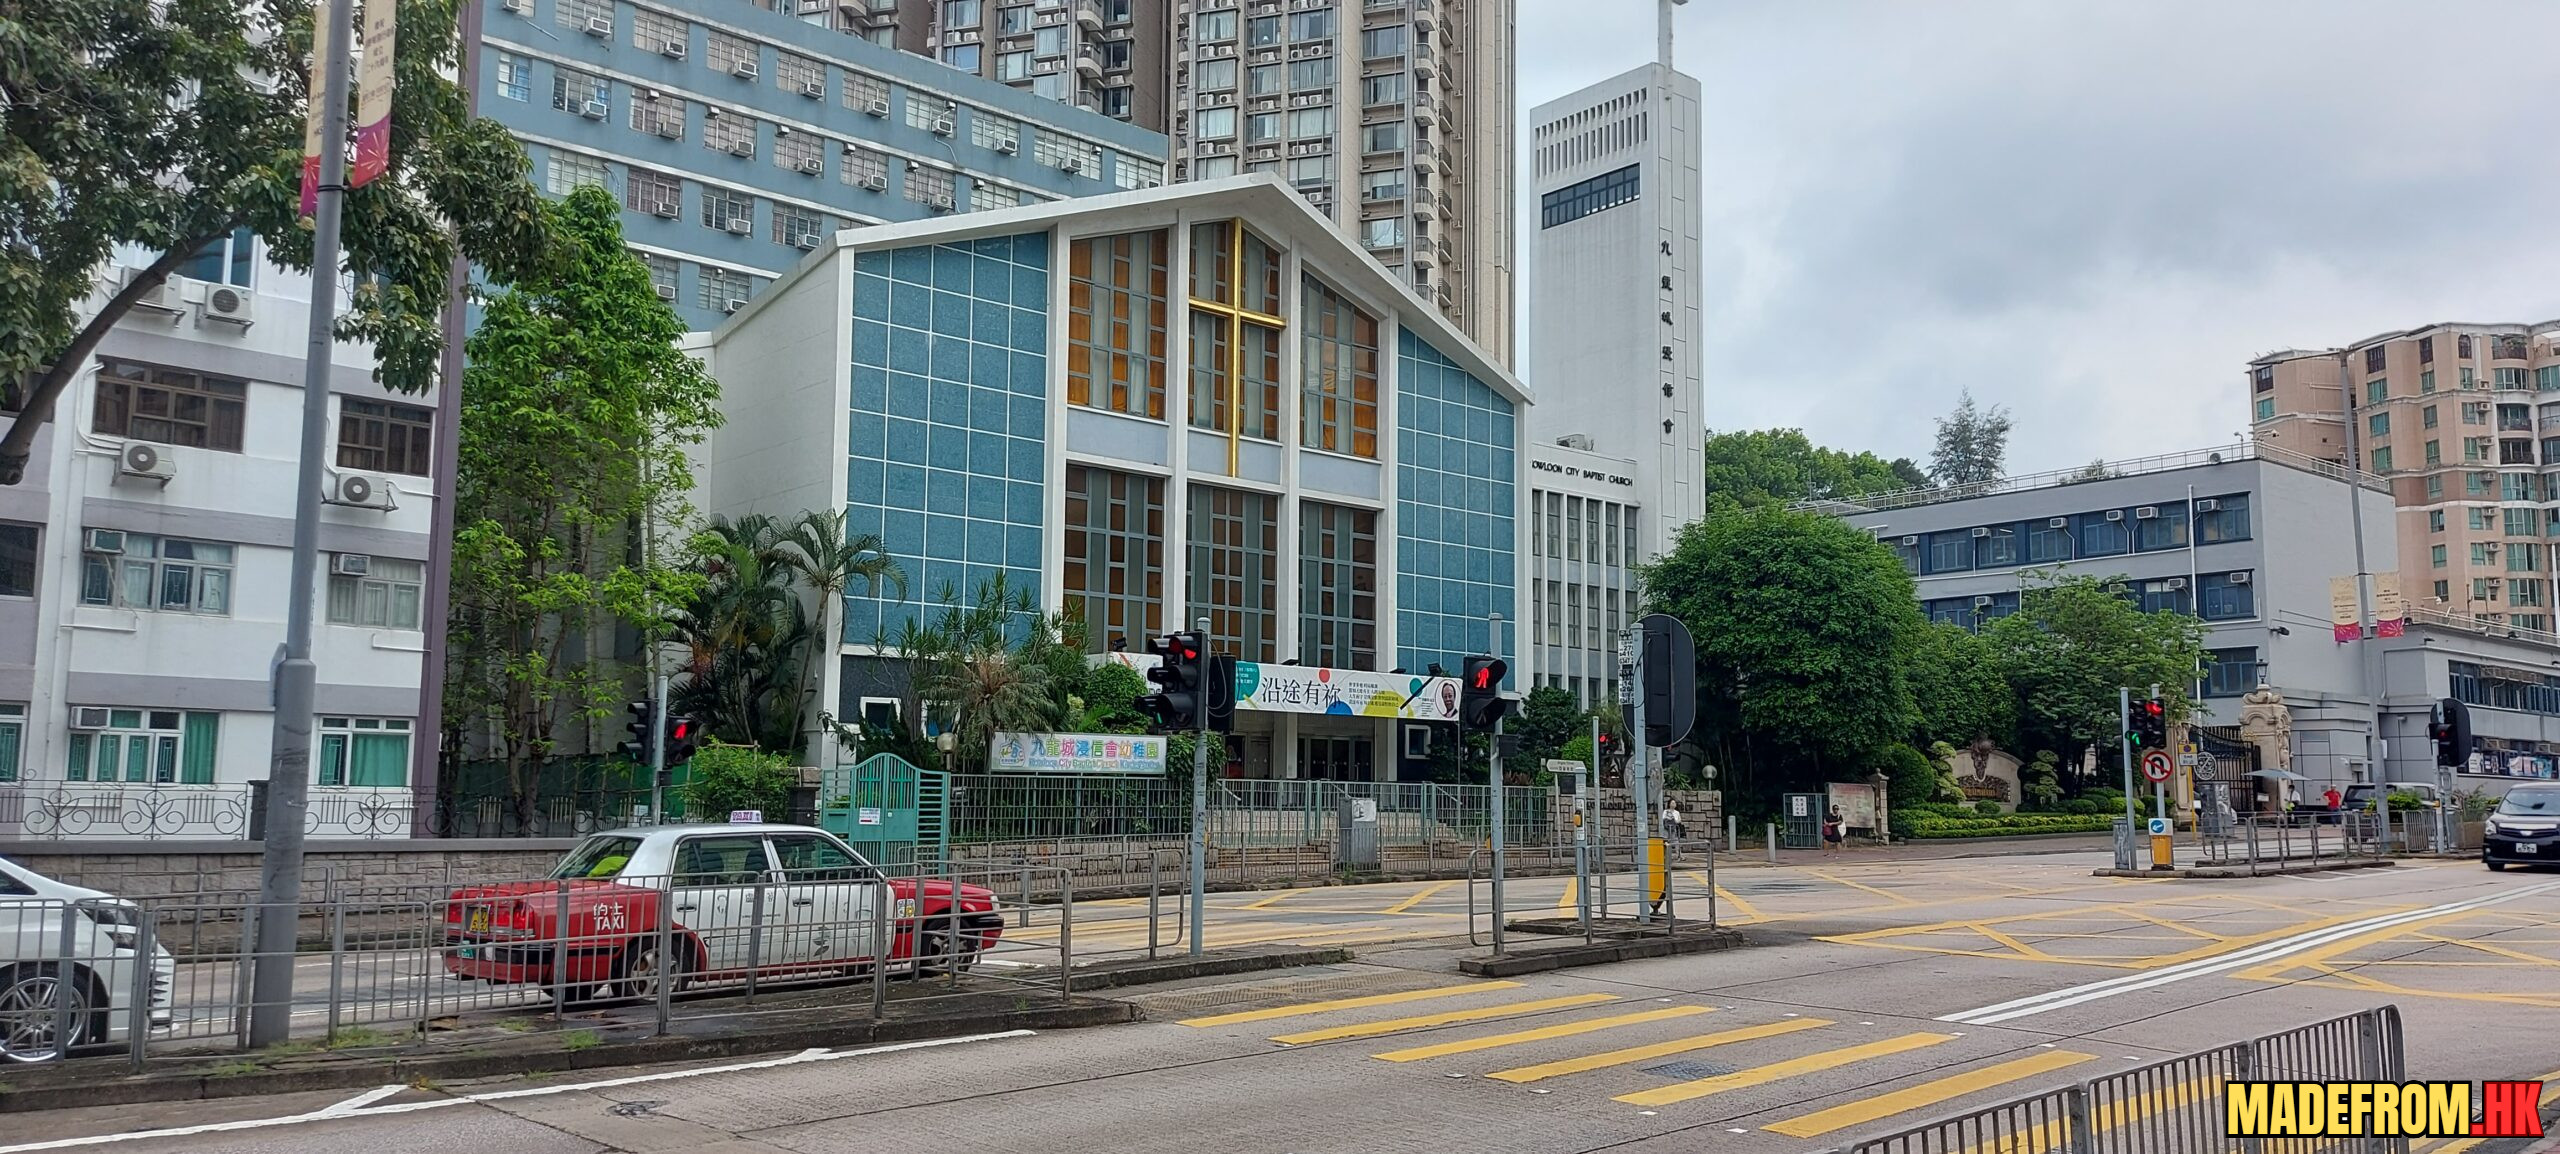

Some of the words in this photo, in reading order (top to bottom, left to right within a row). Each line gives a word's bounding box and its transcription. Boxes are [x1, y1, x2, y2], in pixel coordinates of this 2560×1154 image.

[1566, 466, 1580, 476] CITY
[1583, 470, 1606, 482] BAPTIST
[1609, 475, 1632, 487] CHURCH
[1262, 677, 1341, 709] 沿途有祢
[1030, 737, 1159, 760] 九龍城浸信會幼稚園
[593, 902, 624, 916] 的士
[593, 914, 624, 931] TAXI
